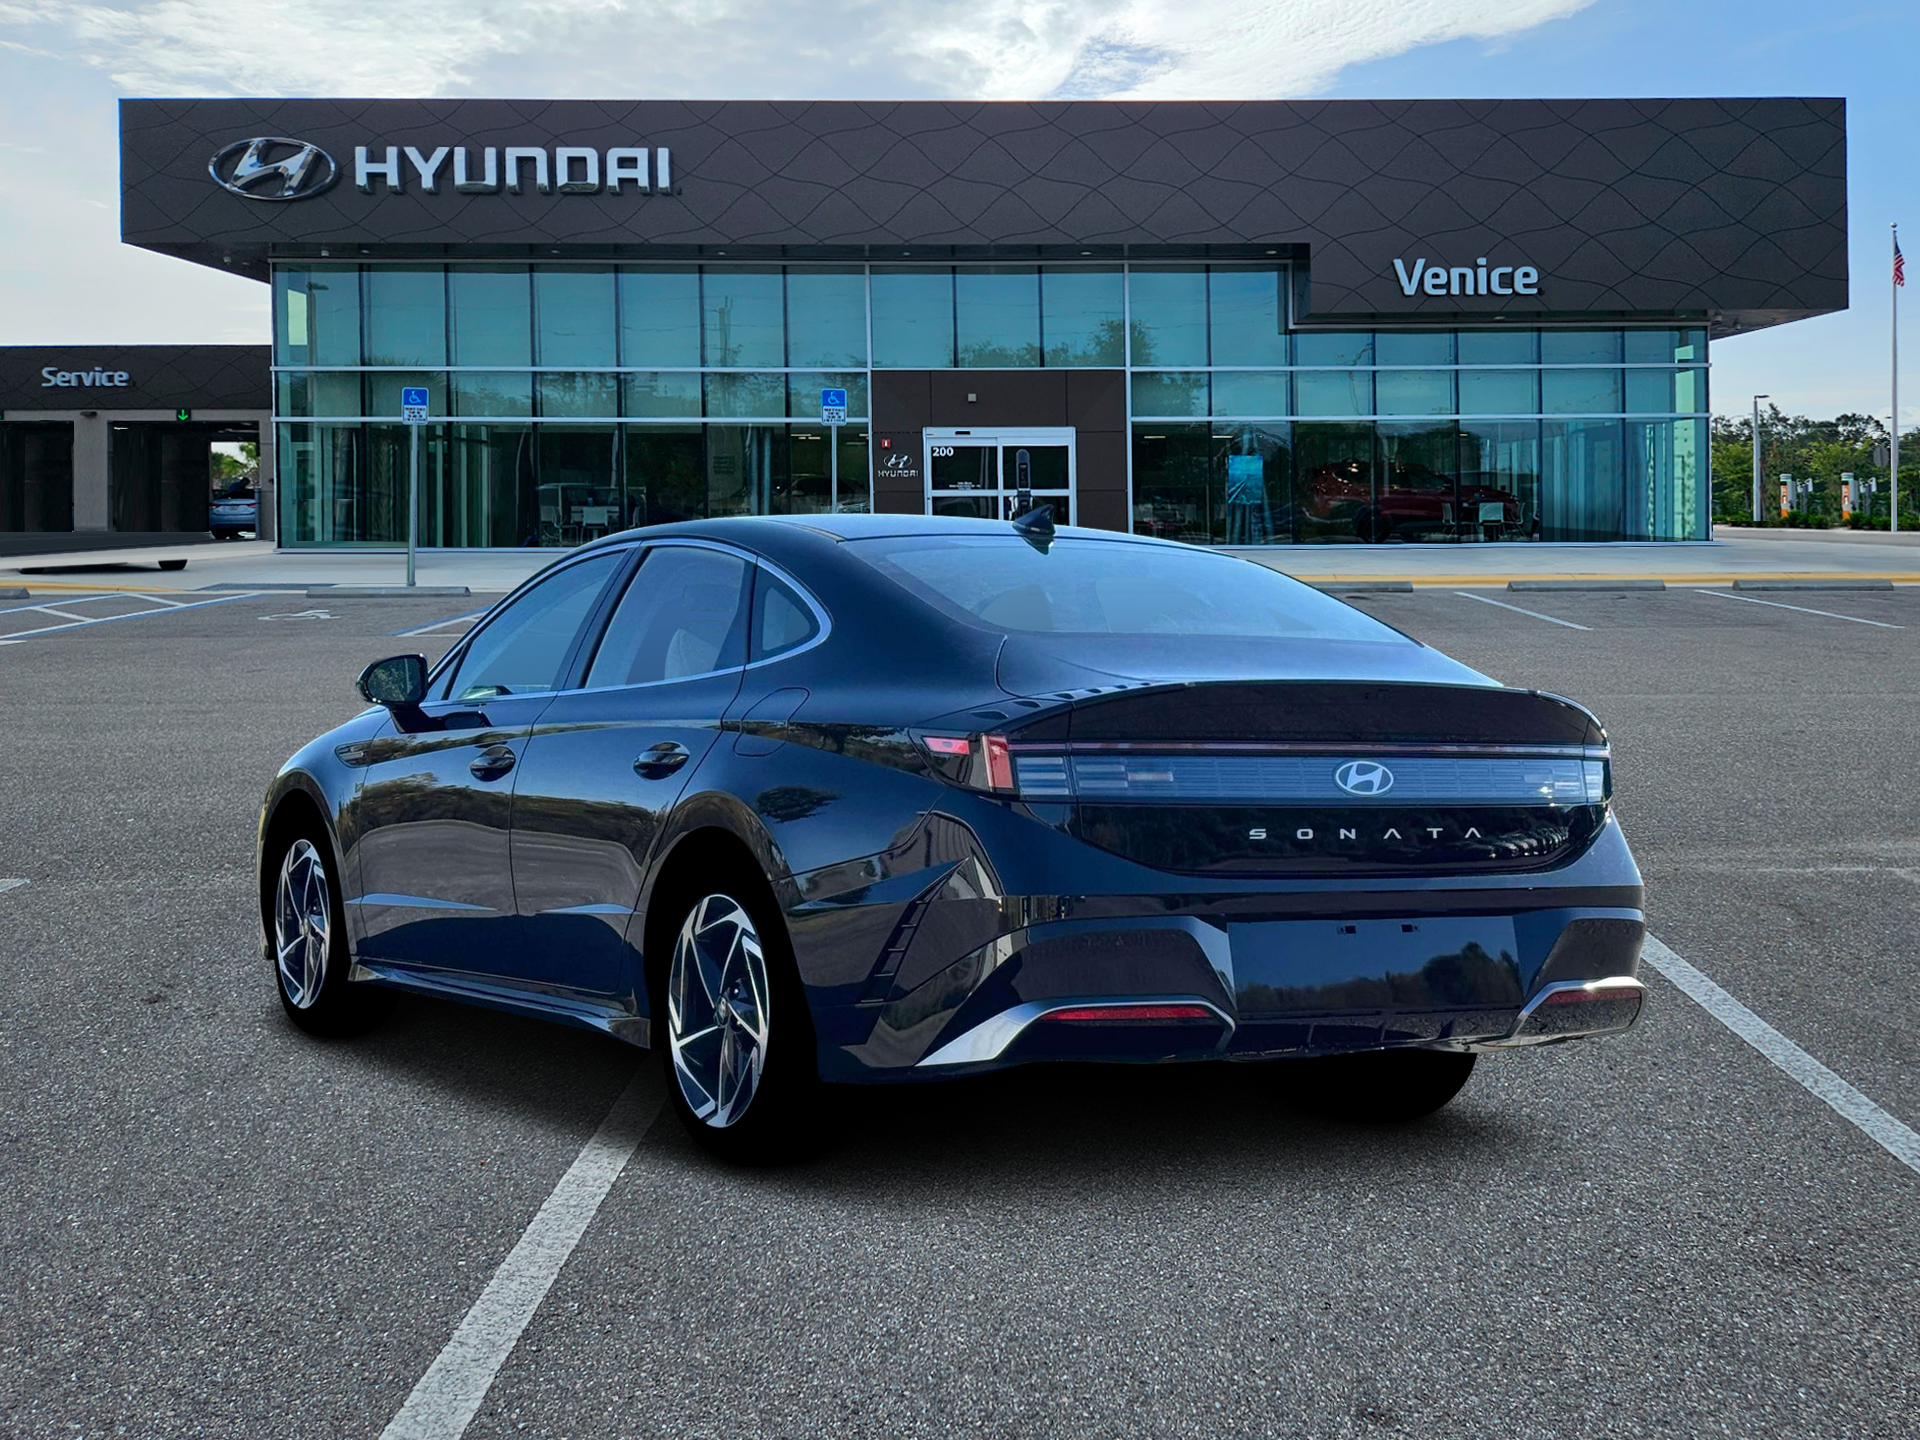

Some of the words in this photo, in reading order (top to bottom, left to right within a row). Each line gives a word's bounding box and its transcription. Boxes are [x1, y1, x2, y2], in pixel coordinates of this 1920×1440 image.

[355, 146, 671, 193] HYUNDAI
[1393, 257, 1538, 296] Venice
[41, 366, 130, 387] Service
[932, 446, 954, 457] 200
[877, 469, 919, 478] HYUNDAI
[1249, 827, 1482, 840] SONATA
